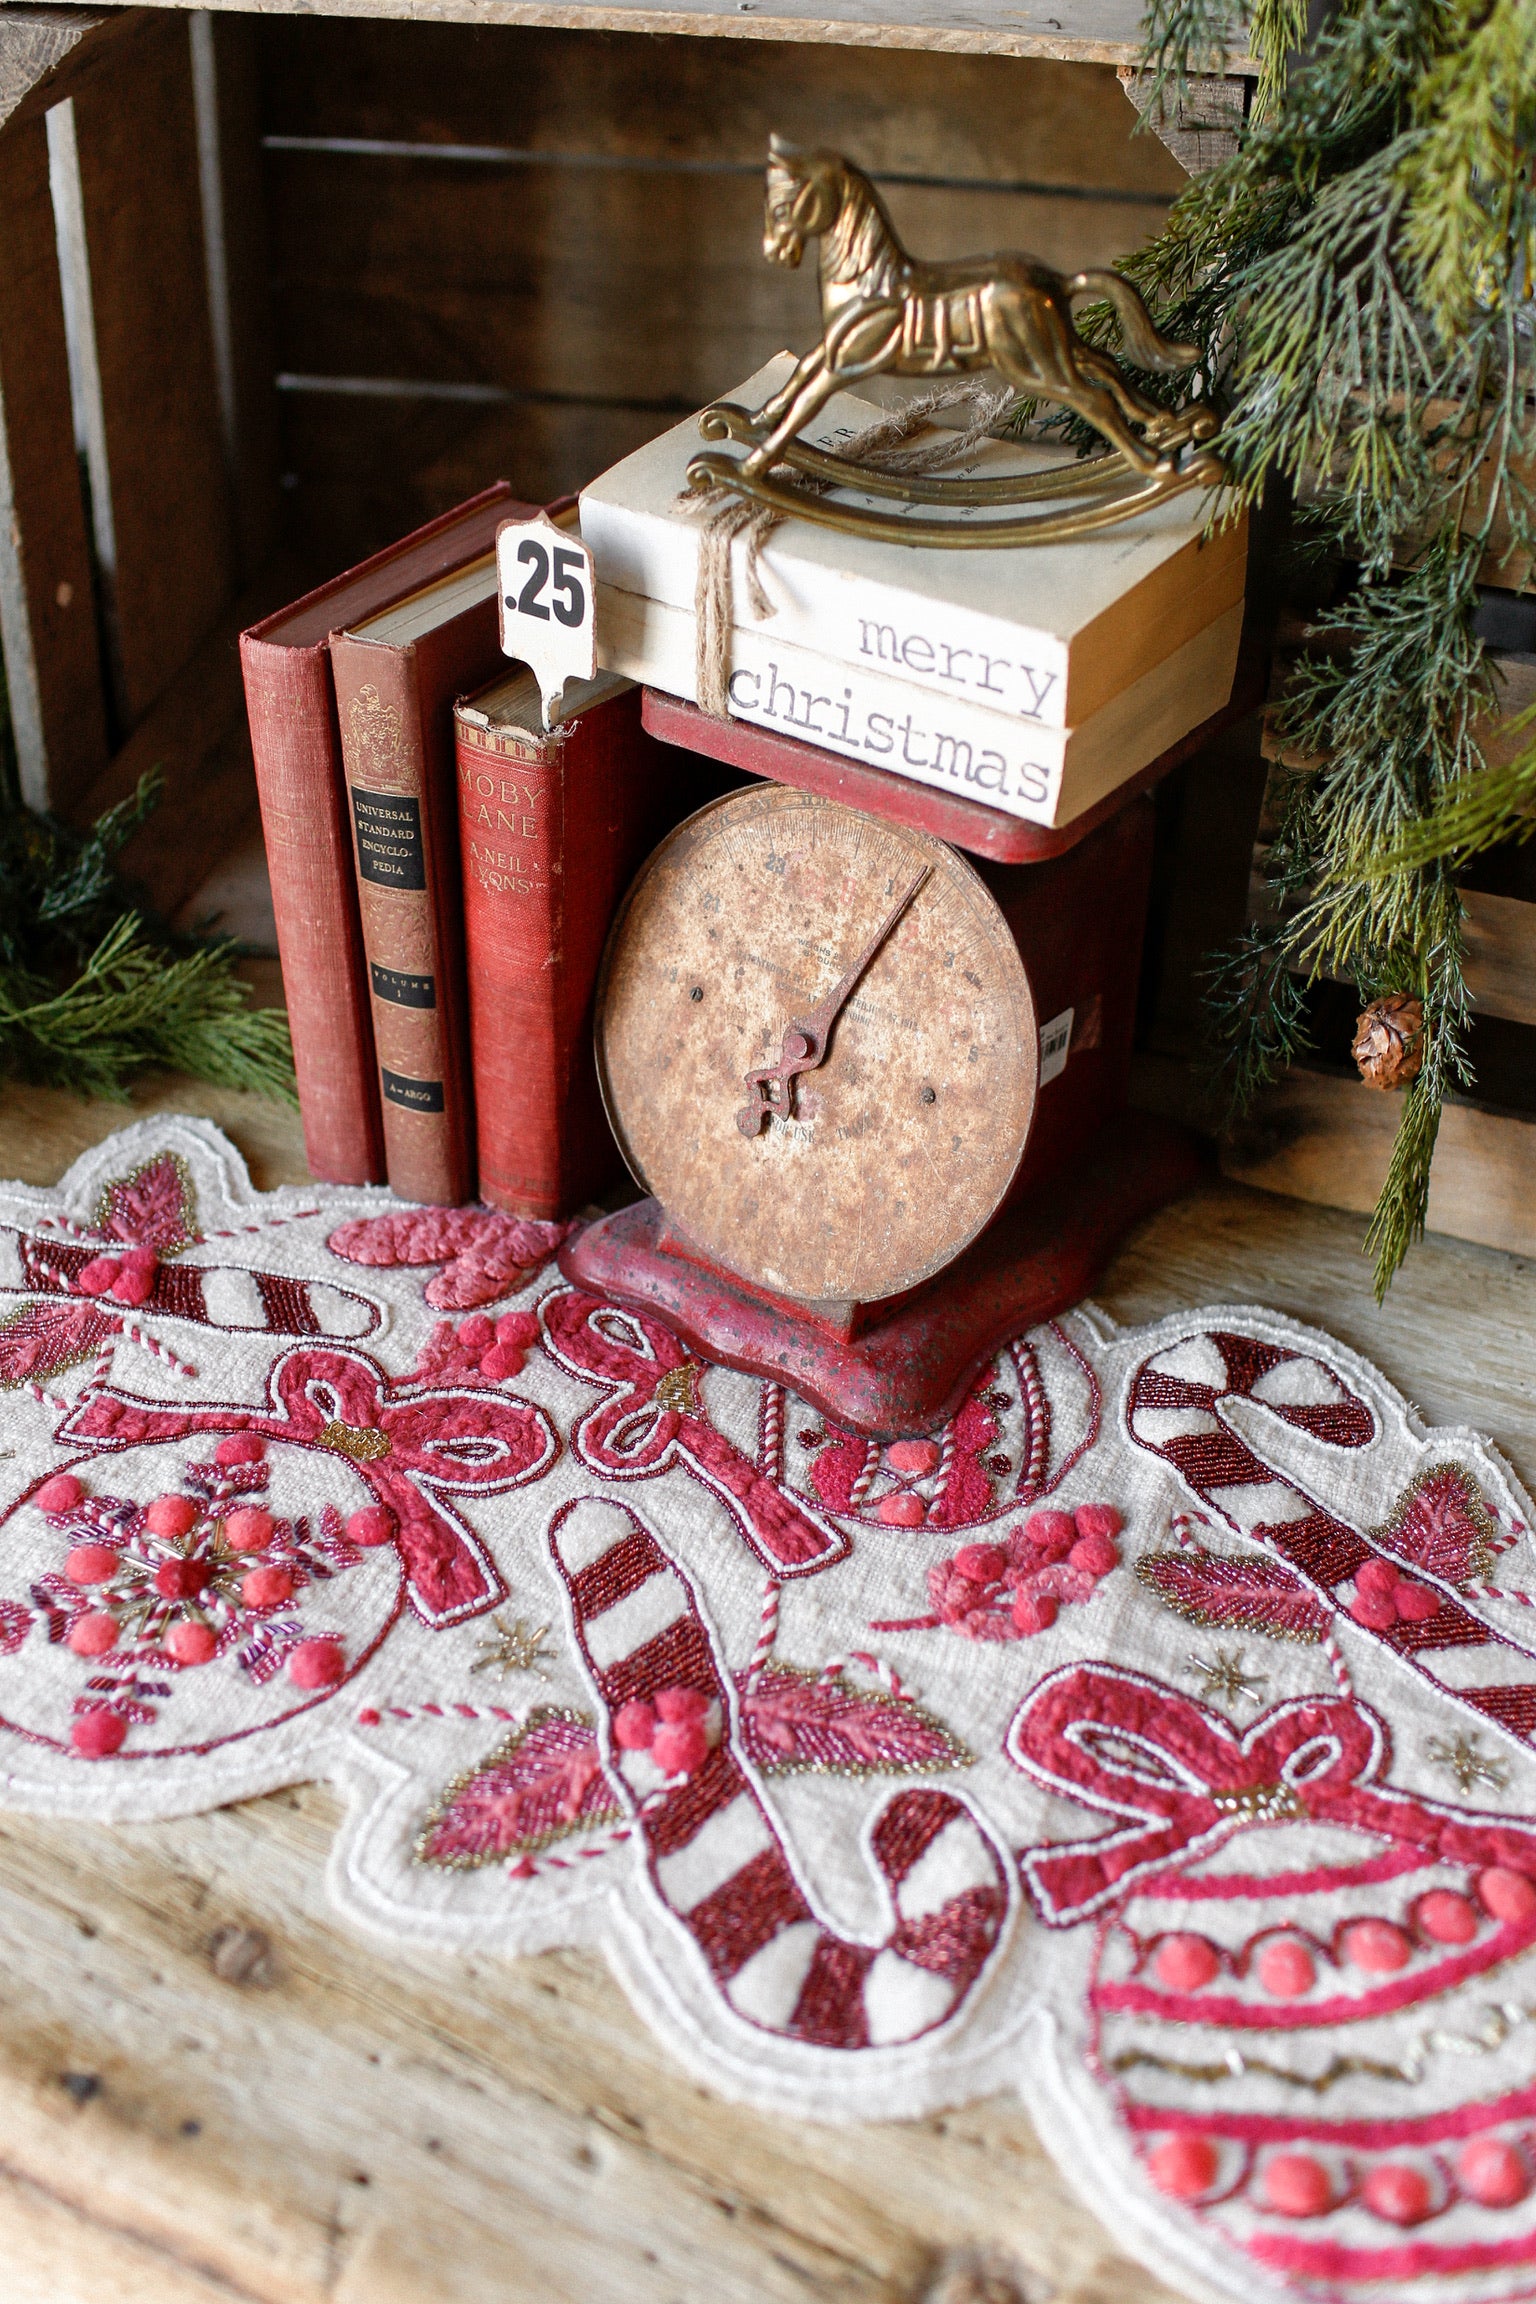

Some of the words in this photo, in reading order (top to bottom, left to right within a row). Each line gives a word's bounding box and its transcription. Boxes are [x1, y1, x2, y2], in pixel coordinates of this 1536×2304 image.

[505, 539, 585, 628] .25
[858, 618, 1057, 720] merry
[727, 662, 1050, 804] christmas
[459, 763, 546, 809] MOBY
[356, 801, 414, 822] UNIVERSAL
[462, 794, 538, 839] LANE
[358, 820, 415, 840] STANDARD
[362, 838, 413, 857] ENCYCLO-
[372, 860, 404, 875] PEDIA
[470, 859, 531, 895] LYONS
[796, 938, 832, 957] WEIGHS
[374, 970, 430, 990] VOLUME
